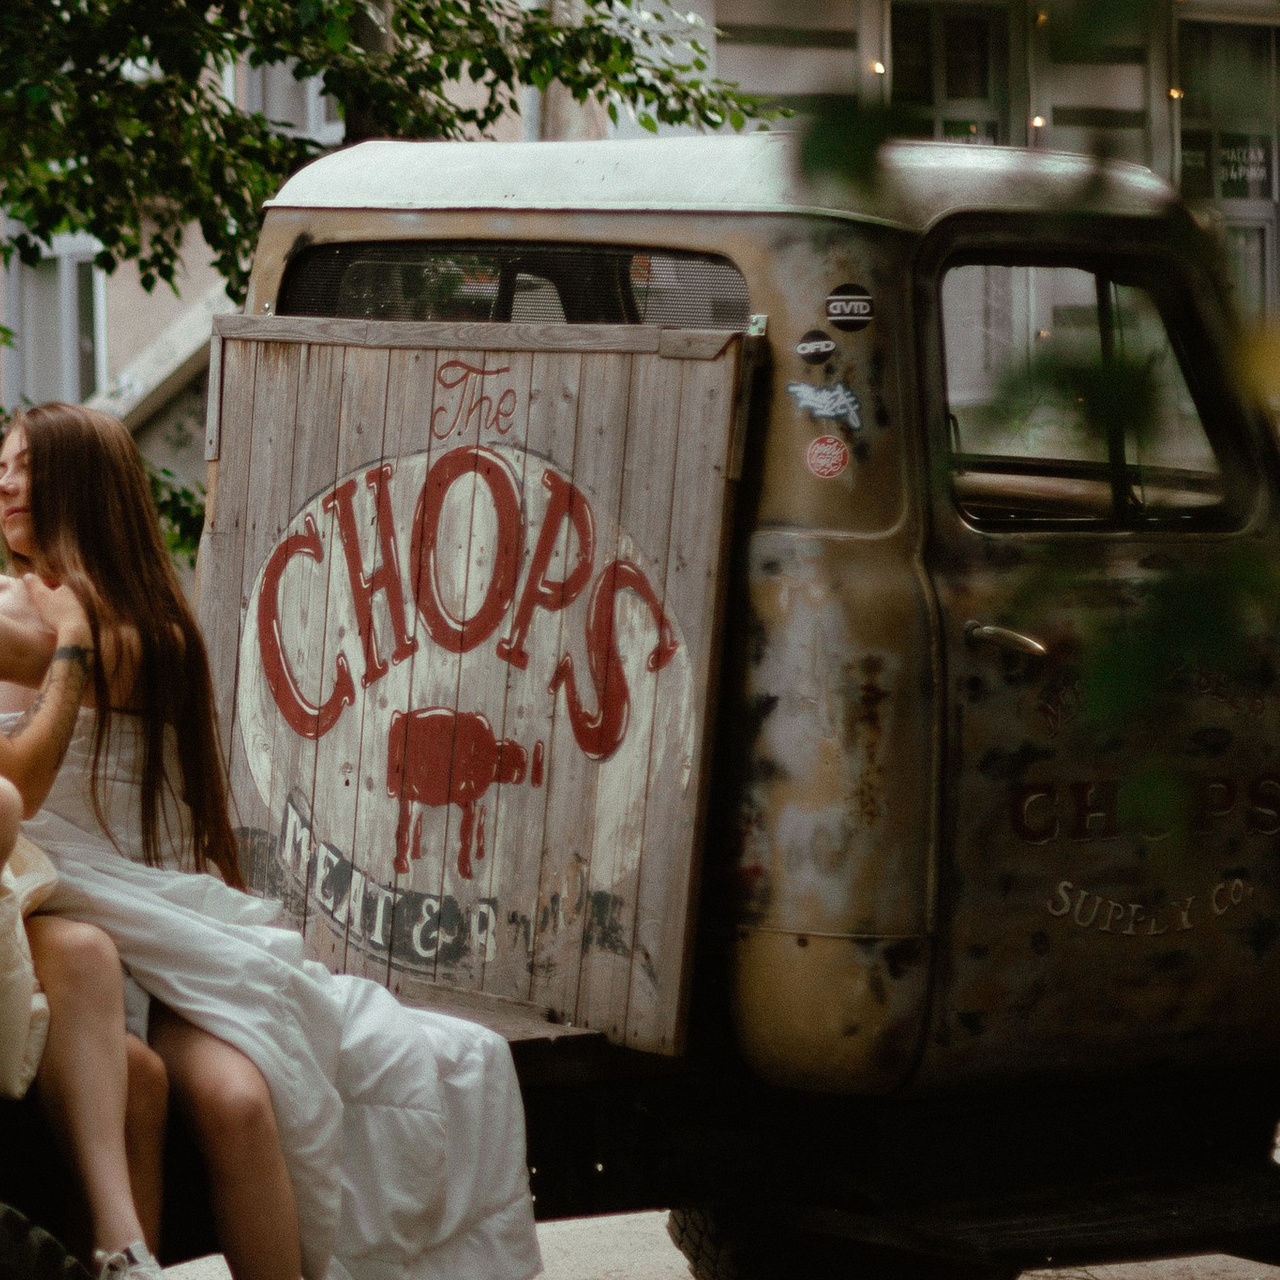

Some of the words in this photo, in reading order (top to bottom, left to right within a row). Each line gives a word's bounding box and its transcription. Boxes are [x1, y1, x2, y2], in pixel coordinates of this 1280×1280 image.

[433, 359, 518, 440] The
[258, 444, 680, 762] CHOPS
[1009, 771, 1280, 845] CHPS
[284, 802, 402, 946] MEAT
[412, 898, 458, 959] &
